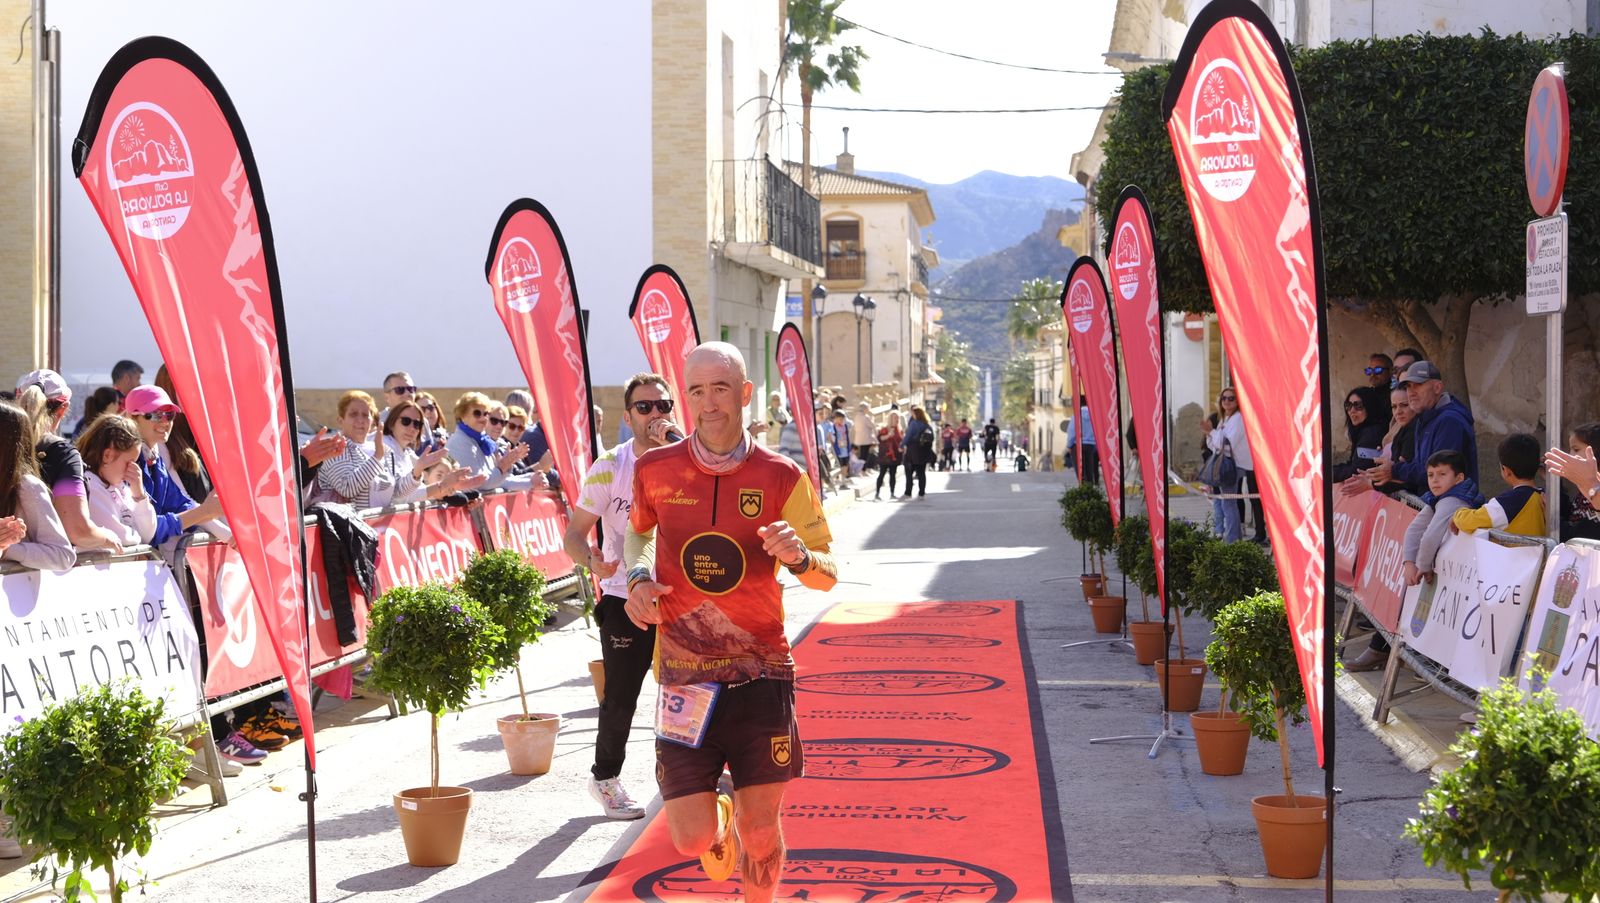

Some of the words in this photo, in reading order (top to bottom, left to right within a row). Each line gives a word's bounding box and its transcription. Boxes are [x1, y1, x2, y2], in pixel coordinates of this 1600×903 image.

[513, 516, 564, 559] VEOLIA
[5, 605, 136, 647] NTAMIENTO
[142, 599, 172, 623] DE
[666, 659, 698, 671] VUESTRA
[701, 658, 732, 671] LUCHA
[780, 813, 968, 821] Ayuntamie
[915, 868, 967, 876] LA
